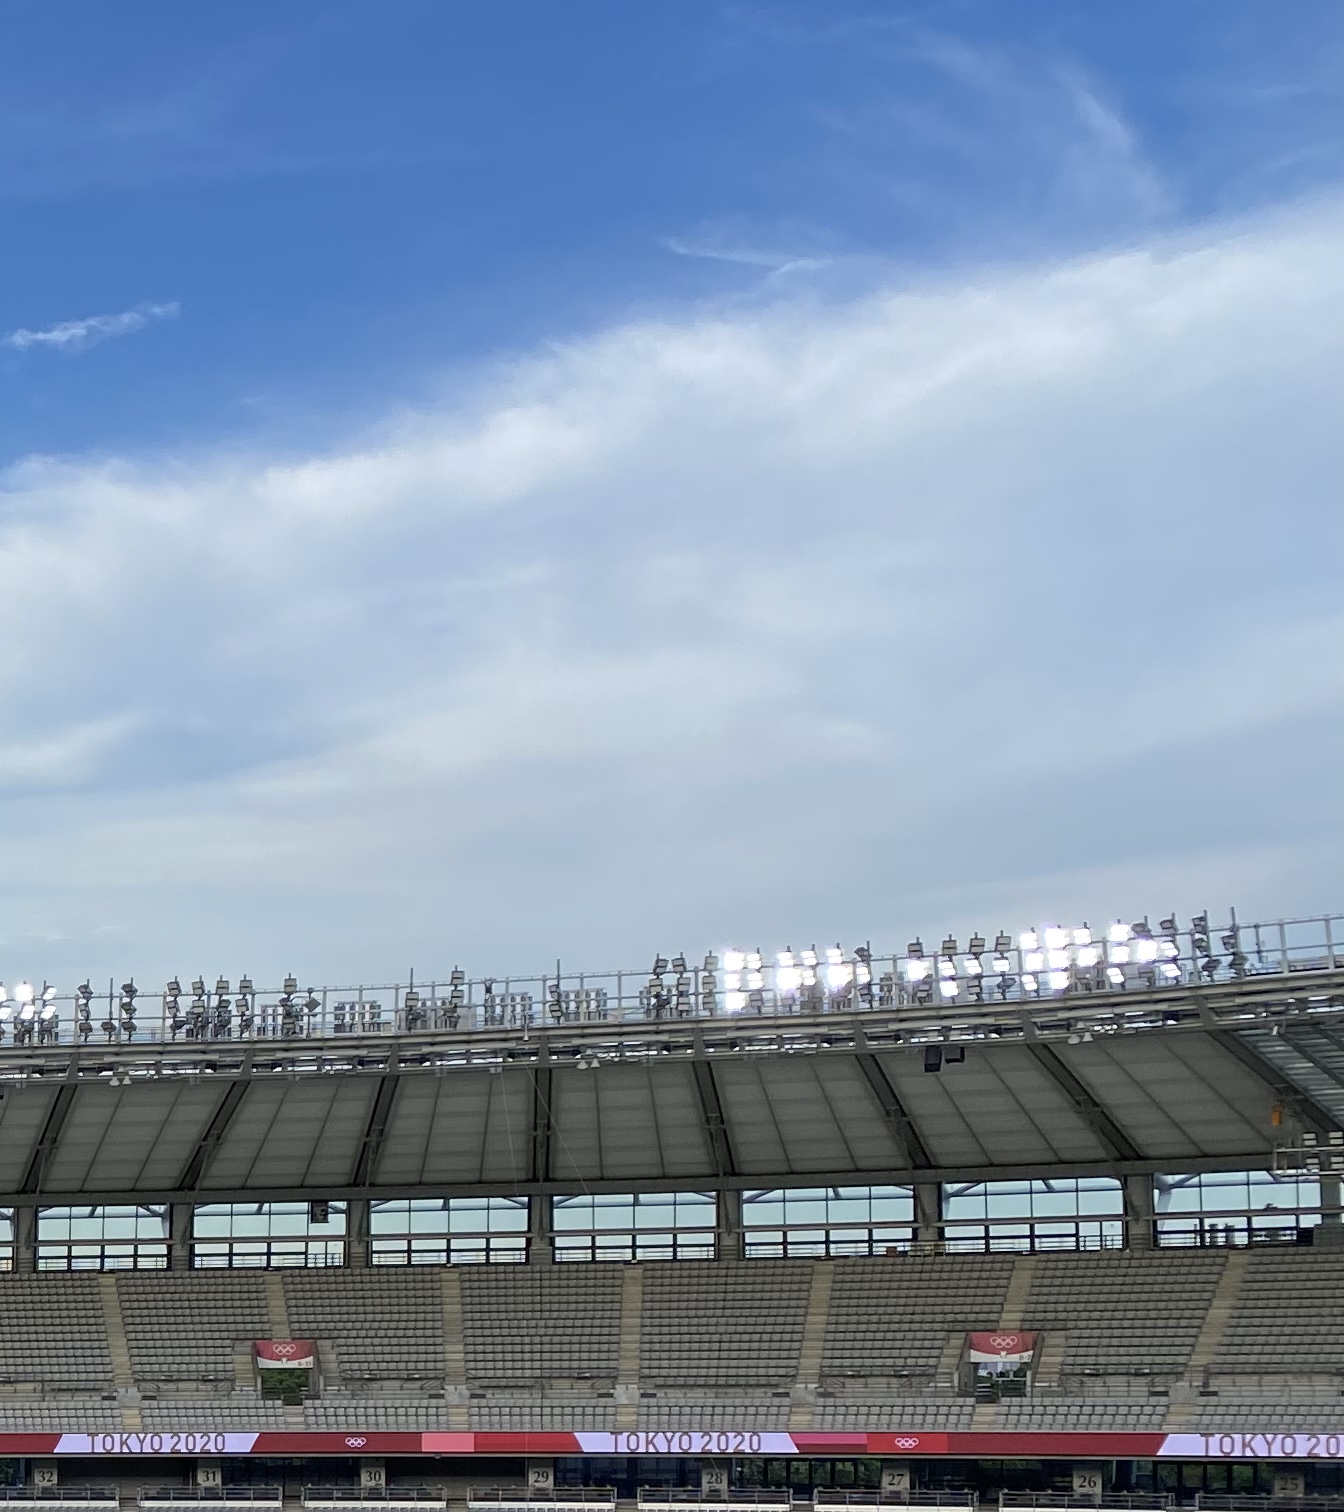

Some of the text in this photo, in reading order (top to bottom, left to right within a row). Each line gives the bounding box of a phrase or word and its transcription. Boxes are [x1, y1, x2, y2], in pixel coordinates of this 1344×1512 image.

[87, 1433, 226, 1453] TOKYO 2020
[610, 1432, 762, 1452] TOKYO 2020
[1199, 1434, 1297, 1456] TOKYO
[39, 1471, 54, 1482] 32
[202, 1471, 217, 1482] 31
[365, 1471, 381, 1482] 30
[533, 1471, 549, 1483] 29
[706, 1472, 723, 1484] 28
[887, 1473, 905, 1486] 27
[1078, 1474, 1097, 1488] 26
[1279, 1477, 1299, 1491] 25
